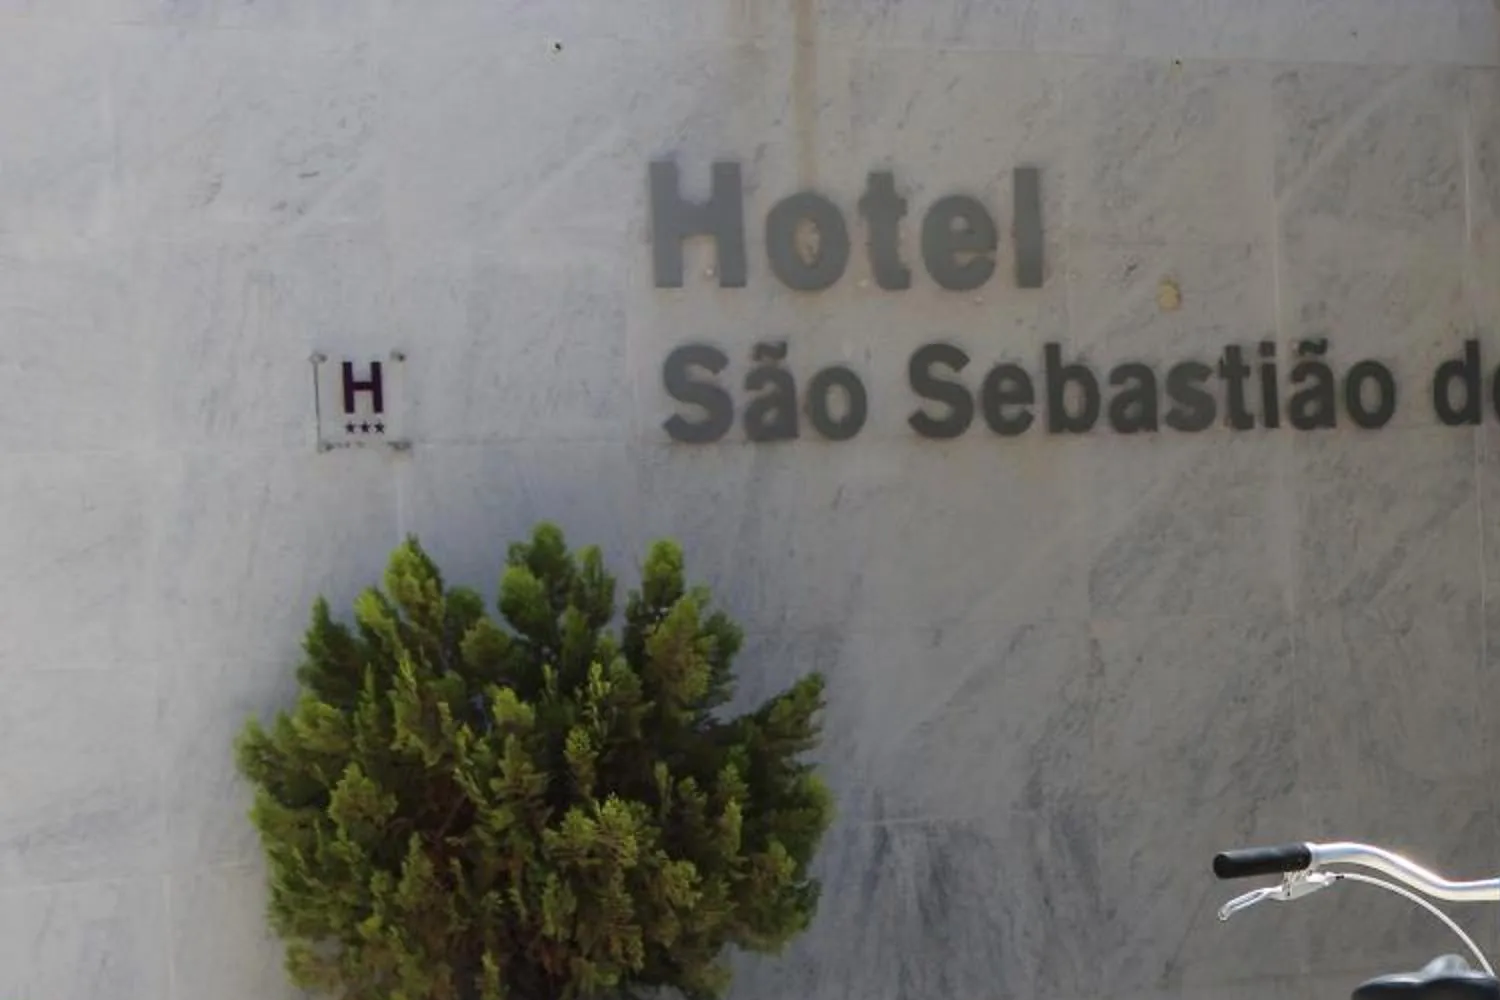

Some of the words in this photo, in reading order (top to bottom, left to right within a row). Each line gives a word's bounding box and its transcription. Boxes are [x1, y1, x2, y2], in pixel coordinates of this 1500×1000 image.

[648, 160, 1045, 290] Hotel
[342, 361, 384, 413] H
[662, 340, 868, 443] São
[907, 337, 1396, 437] Sebastião
